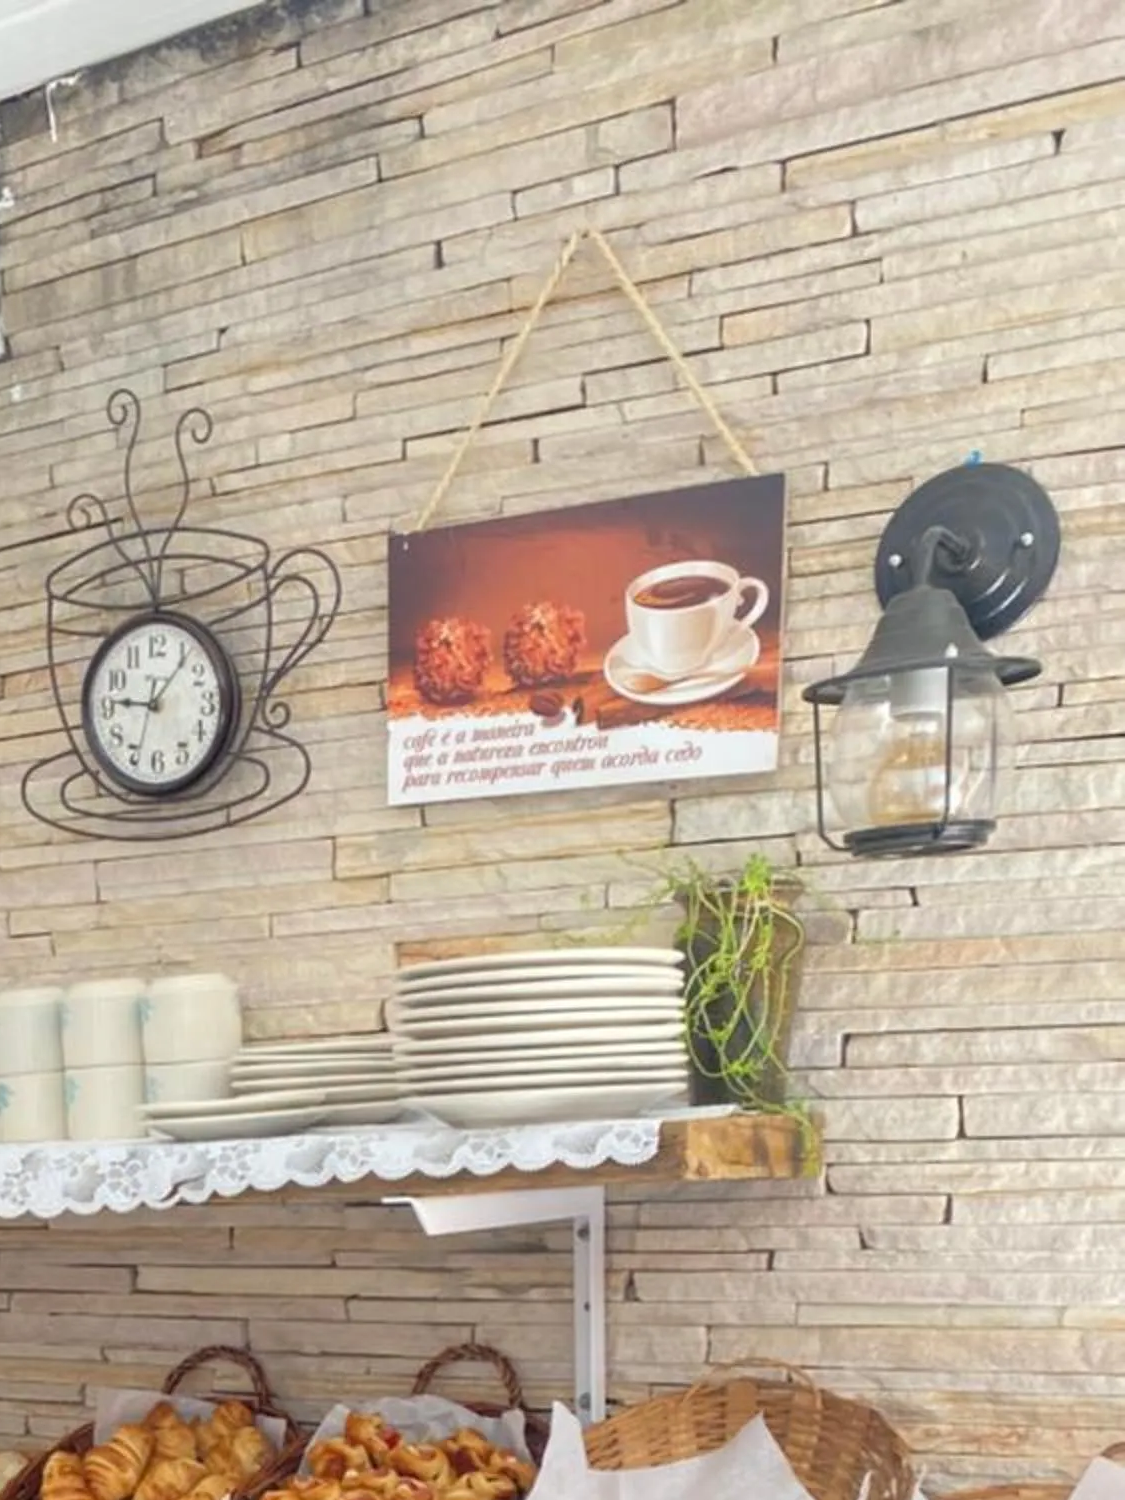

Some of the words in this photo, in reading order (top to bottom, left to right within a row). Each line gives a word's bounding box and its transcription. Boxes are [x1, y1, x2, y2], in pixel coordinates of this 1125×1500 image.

[127, 645, 140, 669] 11
[148, 633, 167, 659] 12
[108, 669, 126, 692] 10
[192, 662, 205, 687] 2
[101, 696, 115, 720] 9
[200, 690, 216, 717] 3
[109, 723, 124, 747] 8
[192, 719, 207, 743] 4
[455, 730, 467, 745] a
[470, 720, 535, 742] maneira
[150, 749, 165, 774] 6
[176, 741, 190, 766] 5
[403, 754, 433, 773] que
[437, 753, 449, 767] a
[453, 743, 525, 764] natureza
[528, 733, 609, 756] encontrou
[402, 770, 441, 793] para
[445, 761, 547, 786] recompensar
[550, 757, 596, 779] quem
[600, 744, 660, 770] acorda
[664, 740, 703, 763] cedo
